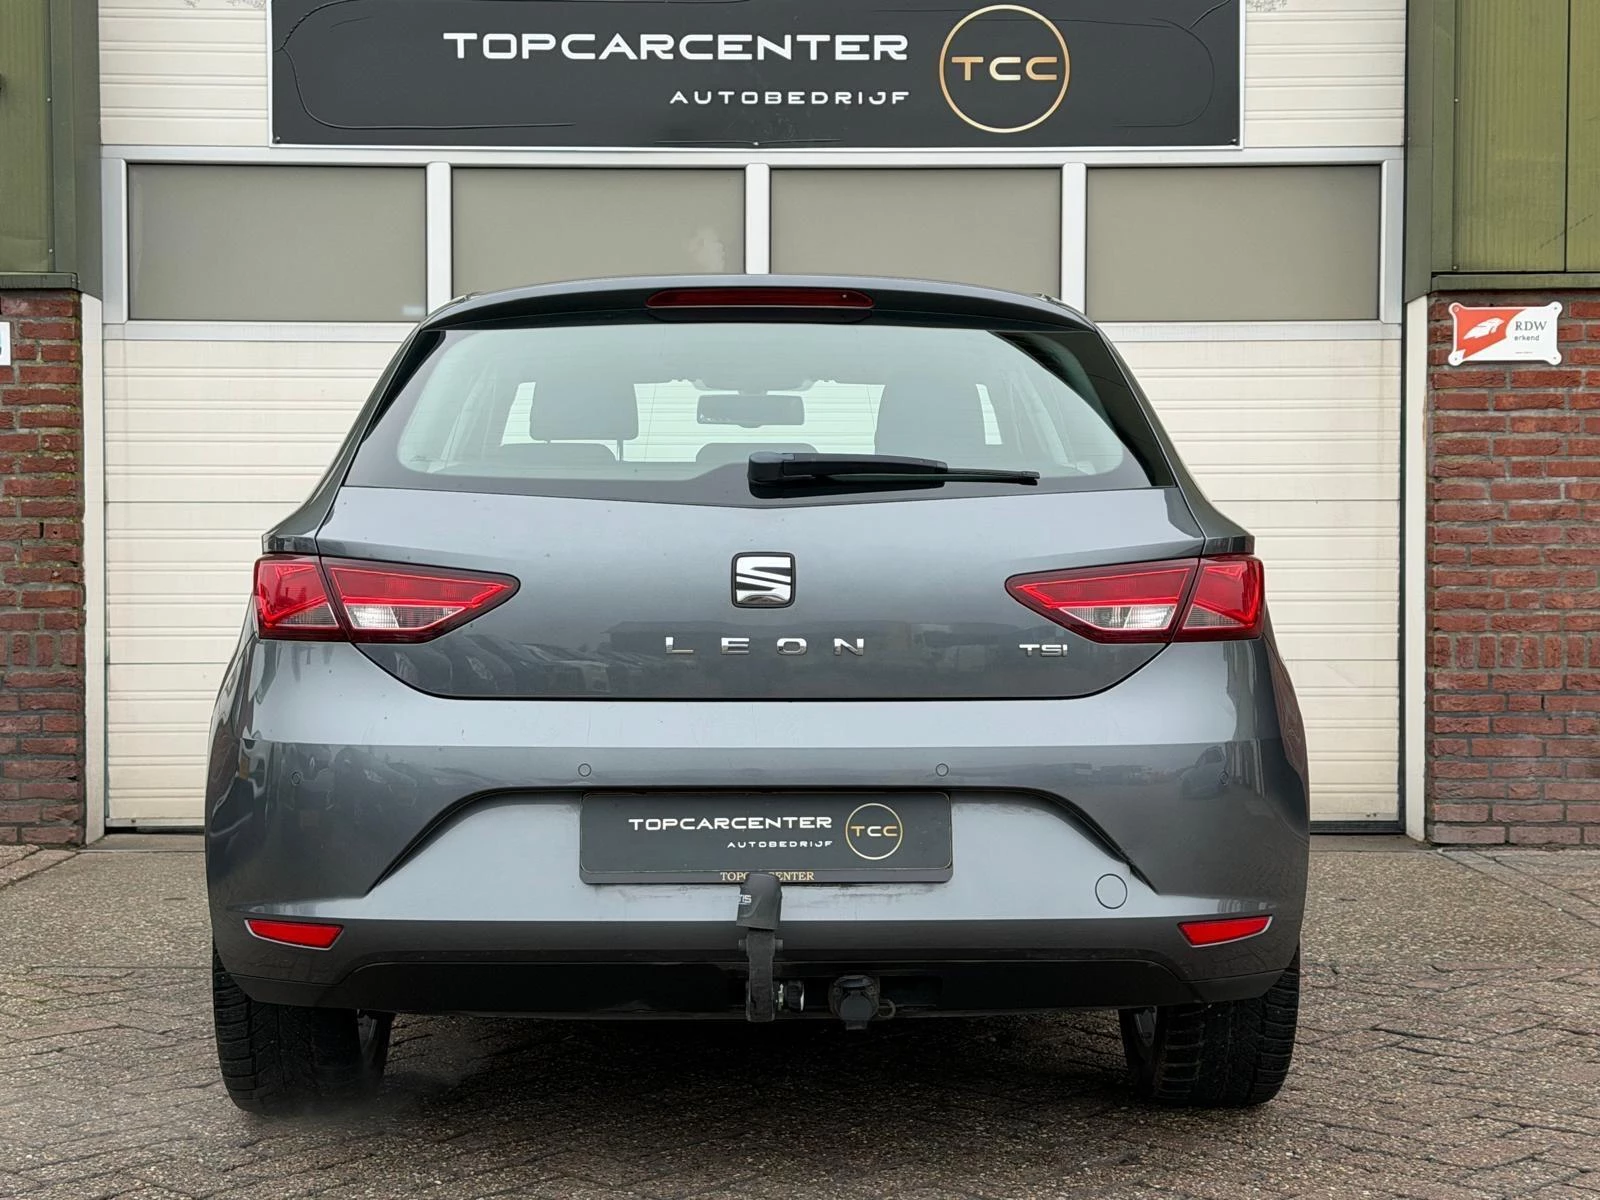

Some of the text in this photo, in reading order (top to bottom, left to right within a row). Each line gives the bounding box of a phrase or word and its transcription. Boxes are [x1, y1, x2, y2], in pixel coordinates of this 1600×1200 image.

[443, 32, 909, 61] TOPCARCENTER
[951, 56, 1058, 81] TCC
[669, 90, 910, 105] AUTOBEDRIJF
[1515, 320, 1547, 331] RDW
[665, 636, 865, 656] LEON
[1018, 643, 1068, 657] TSI
[628, 816, 832, 831] TOPCARCENTER
[850, 825, 898, 837] TCC
[727, 840, 832, 849] AUTOBEDRIJF
